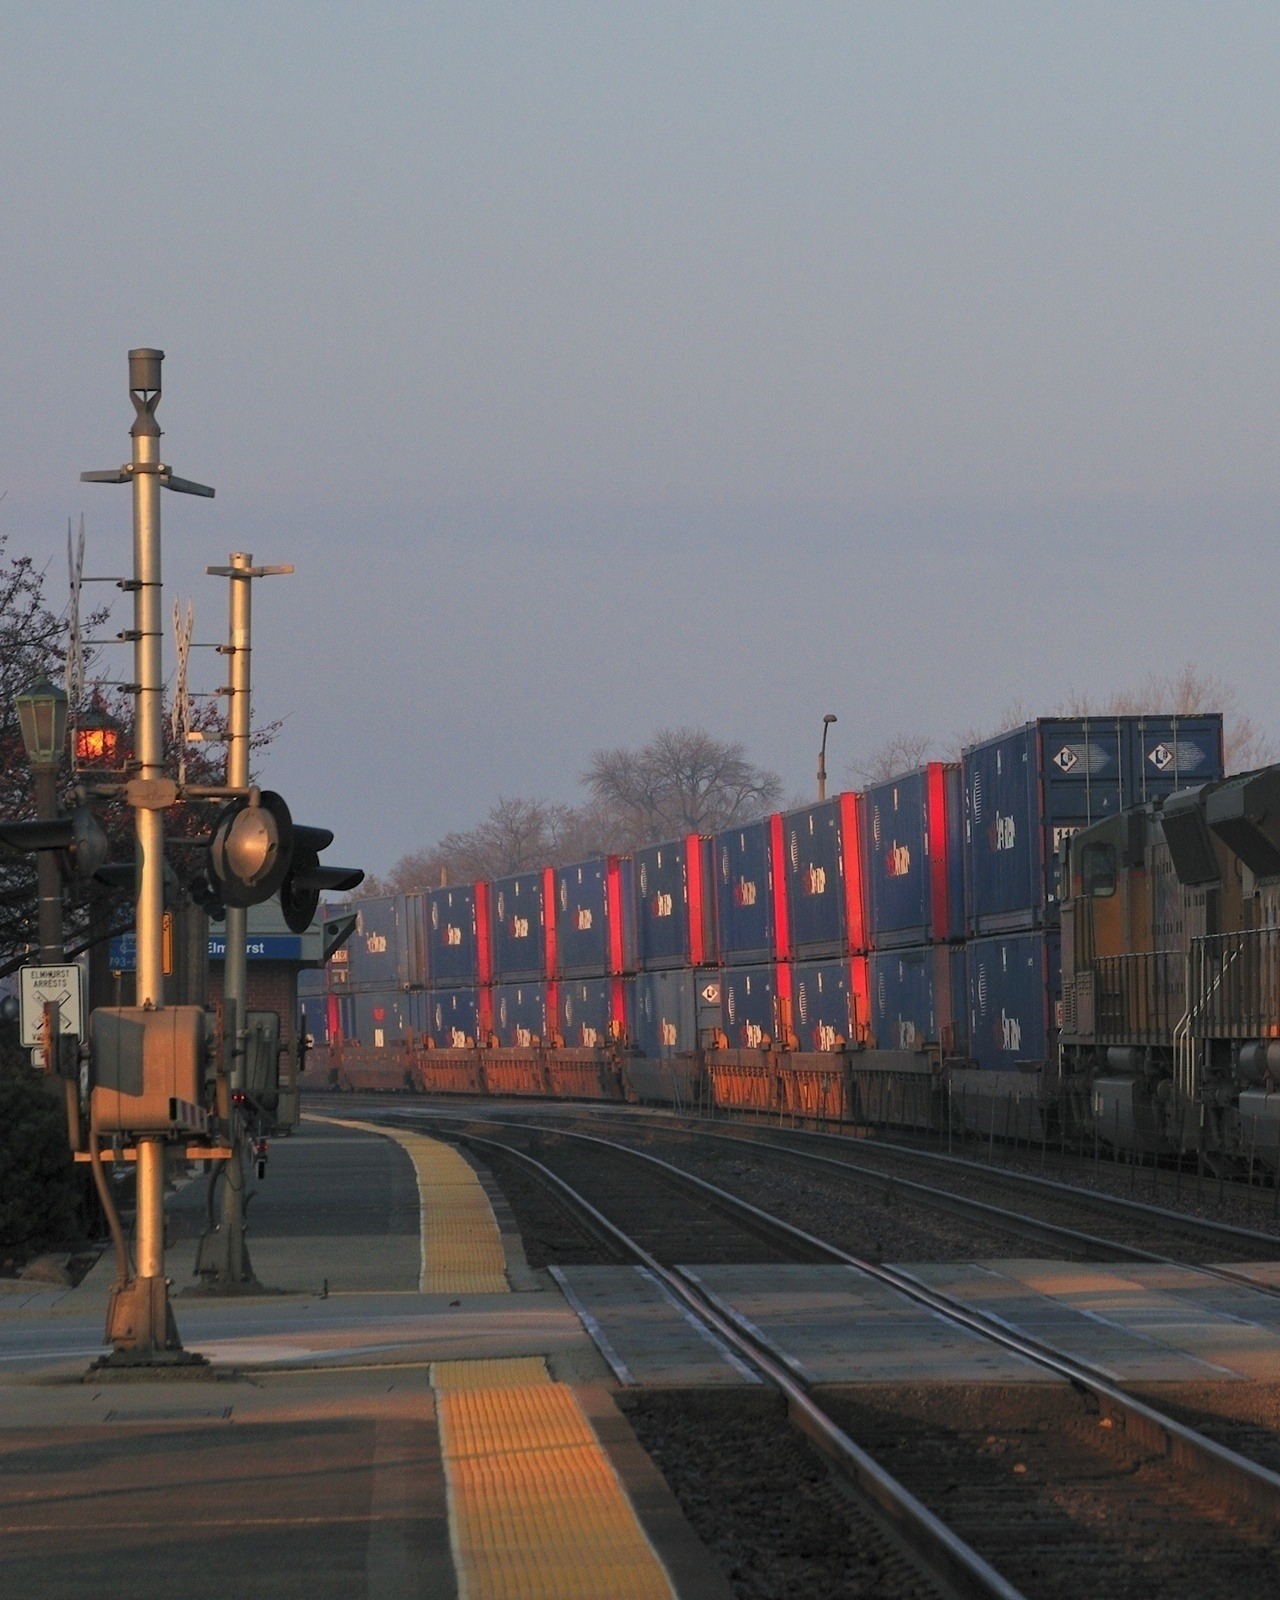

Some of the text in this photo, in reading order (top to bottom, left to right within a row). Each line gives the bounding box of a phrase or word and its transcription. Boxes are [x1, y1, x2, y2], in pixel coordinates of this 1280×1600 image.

[208, 942, 264, 953] Elmrst
[31, 970, 70, 979] ELMHURST
[33, 980, 67, 988] ARRESTS
